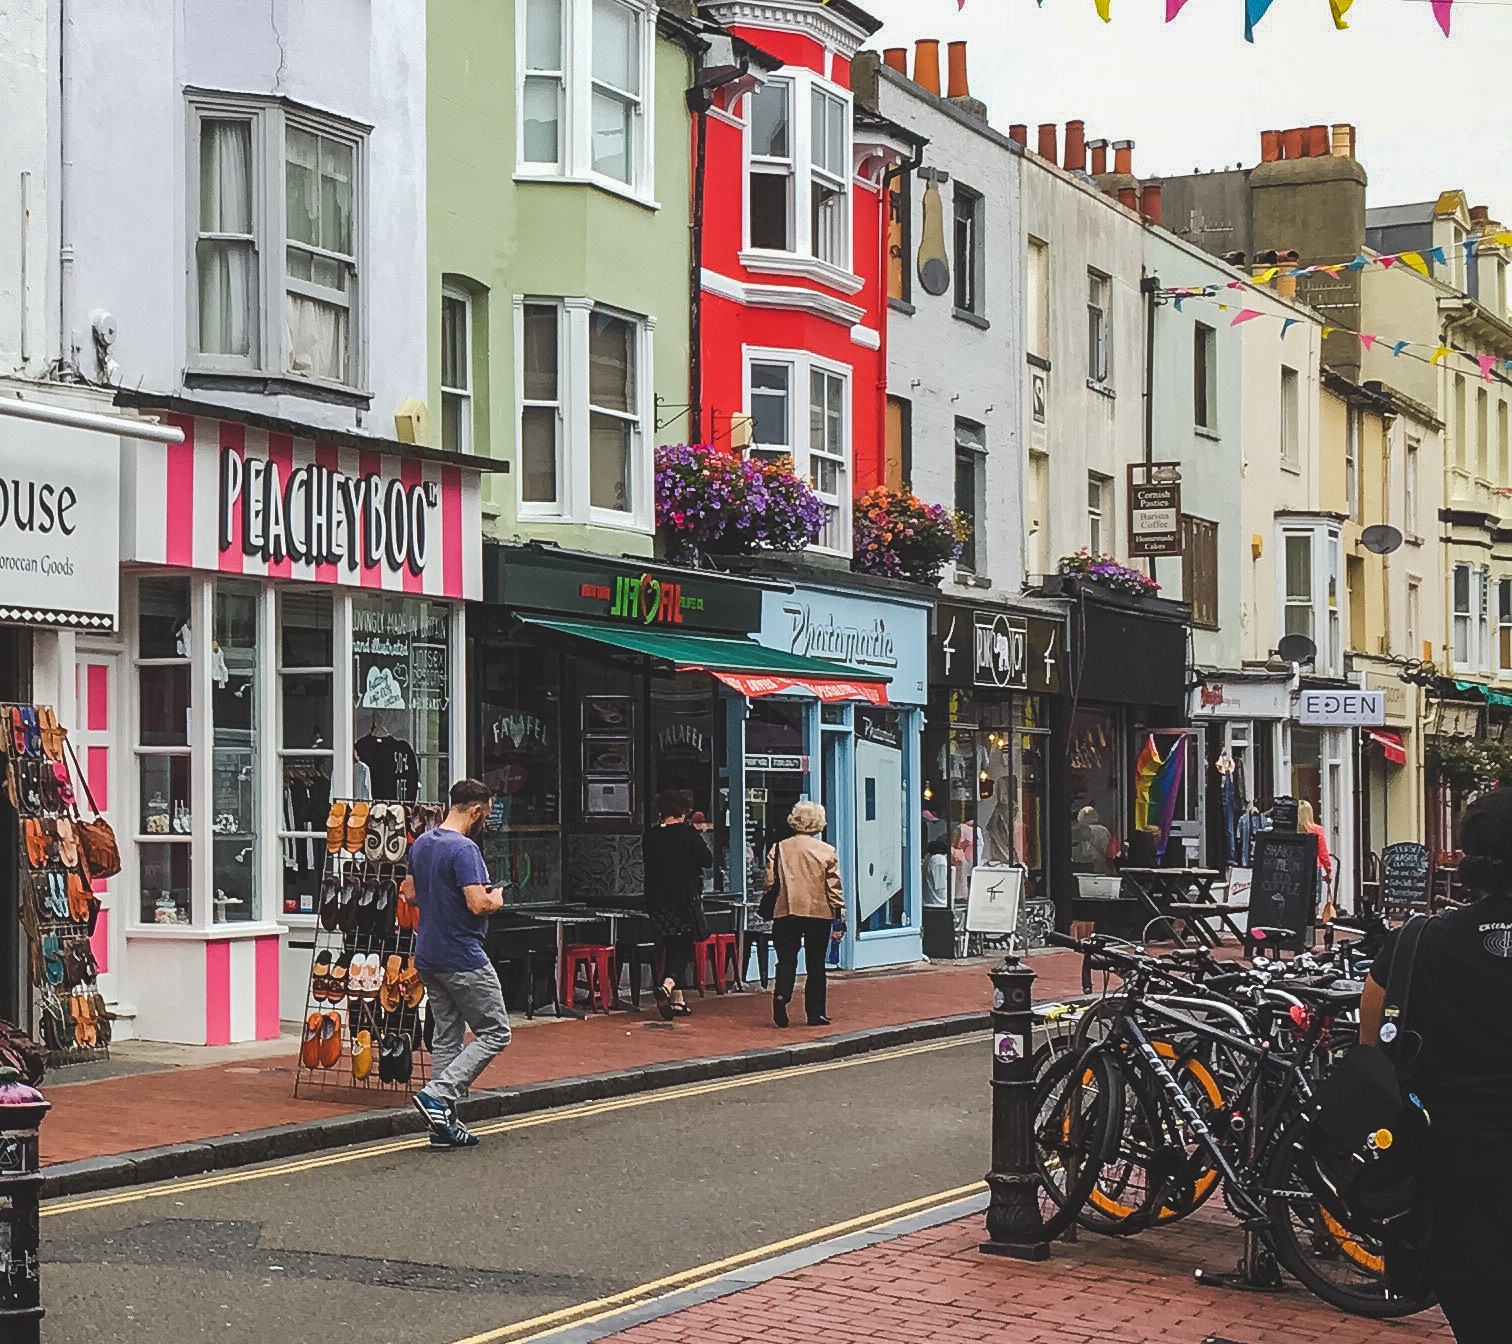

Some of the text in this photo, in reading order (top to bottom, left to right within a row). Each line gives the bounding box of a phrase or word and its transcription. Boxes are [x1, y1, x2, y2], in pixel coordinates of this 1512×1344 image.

[1138, 490, 1171, 500] Cornish
[1140, 499, 1169, 508] Pasties
[1140, 520, 1168, 529] Coffee
[1144, 542, 1166, 550] Cakes
[41, 554, 74, 577] Goods
[352, 637, 370, 653] and
[1307, 696, 1376, 714] EDEN
[658, 723, 703, 753] FALAFEL
